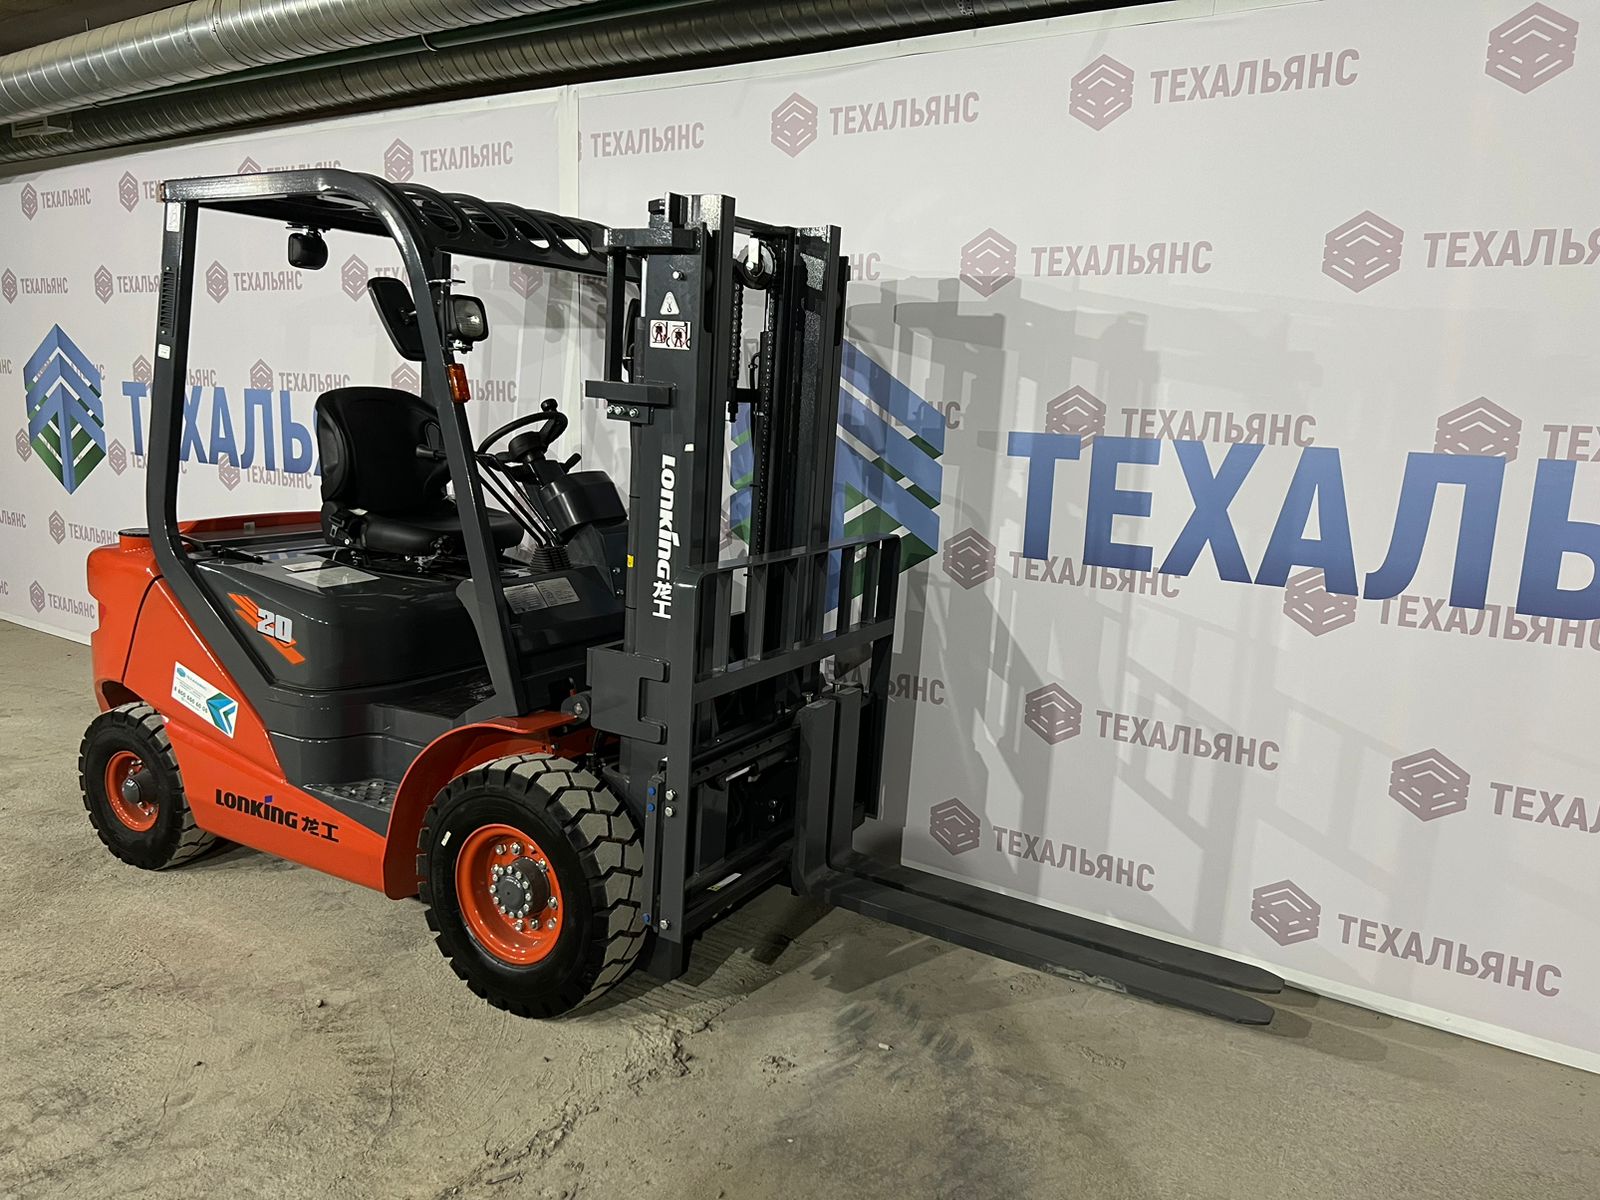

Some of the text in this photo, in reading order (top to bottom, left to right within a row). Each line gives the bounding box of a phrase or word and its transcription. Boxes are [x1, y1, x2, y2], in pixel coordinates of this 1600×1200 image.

[1150, 48, 1360, 104] ТЕХАЛЬЯНС
[830, 91, 980, 136] ТЕХАЛЬЯНС
[420, 140, 514, 173] ТЕХАЛЬЯНС
[590, 122, 705, 158] ТЕХАЛЬЯНС
[40, 187, 92, 210] ТЕХАЛЬЯНС
[1030, 240, 1213, 278] ТЕХАЛЬЯНС
[20, 277, 69, 294] ТЕХАЛЬЯНС
[233, 271, 303, 292] ТЕХАЛЬЯНС
[122, 381, 314, 475] ТХАЛЬ
[1121, 408, 1317, 447] ТЕХАЛЬЯНС
[1007, 431, 1600, 621] ТЕХАЛЬ
[48, 593, 96, 619] ТЕХАЛЬЯНС
[257, 607, 293, 643] 20
[1096, 708, 1280, 771] ТЕХАЛЬЯНС
[993, 824, 1155, 892] ТЕХАЛЬЯНС
[1338, 913, 1562, 998] ТЕХАЛЬЯНС
